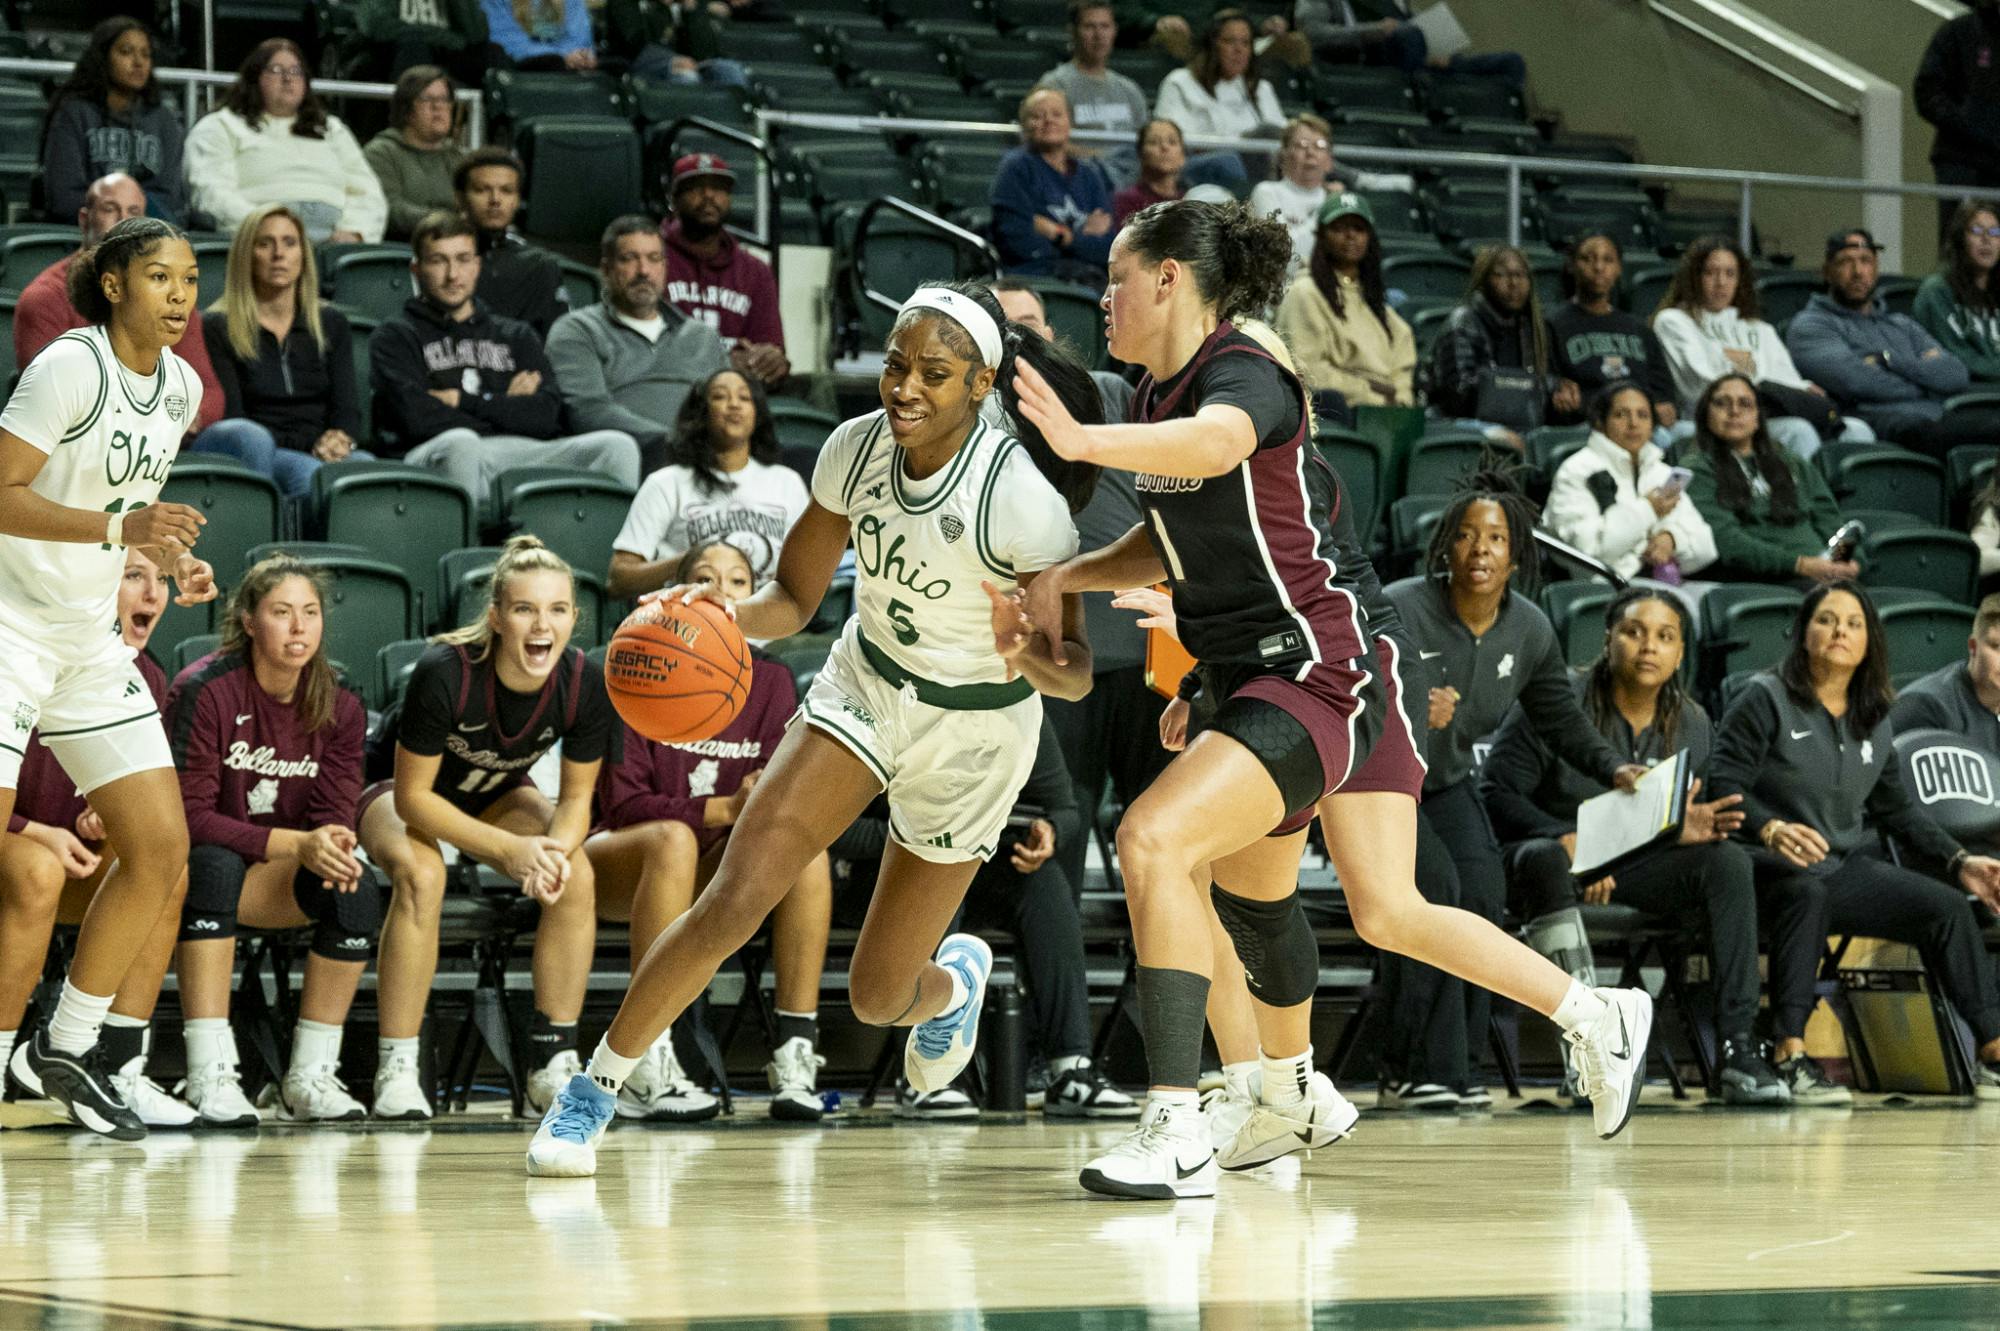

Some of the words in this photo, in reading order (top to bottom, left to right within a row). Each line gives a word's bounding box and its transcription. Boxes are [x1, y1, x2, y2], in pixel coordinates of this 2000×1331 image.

[858, 514, 951, 600] Ohio
[1148, 507, 1186, 582] 1
[886, 597, 921, 646] 5
[608, 647, 678, 673] LEGACY
[1911, 746, 1994, 806] OHIO
